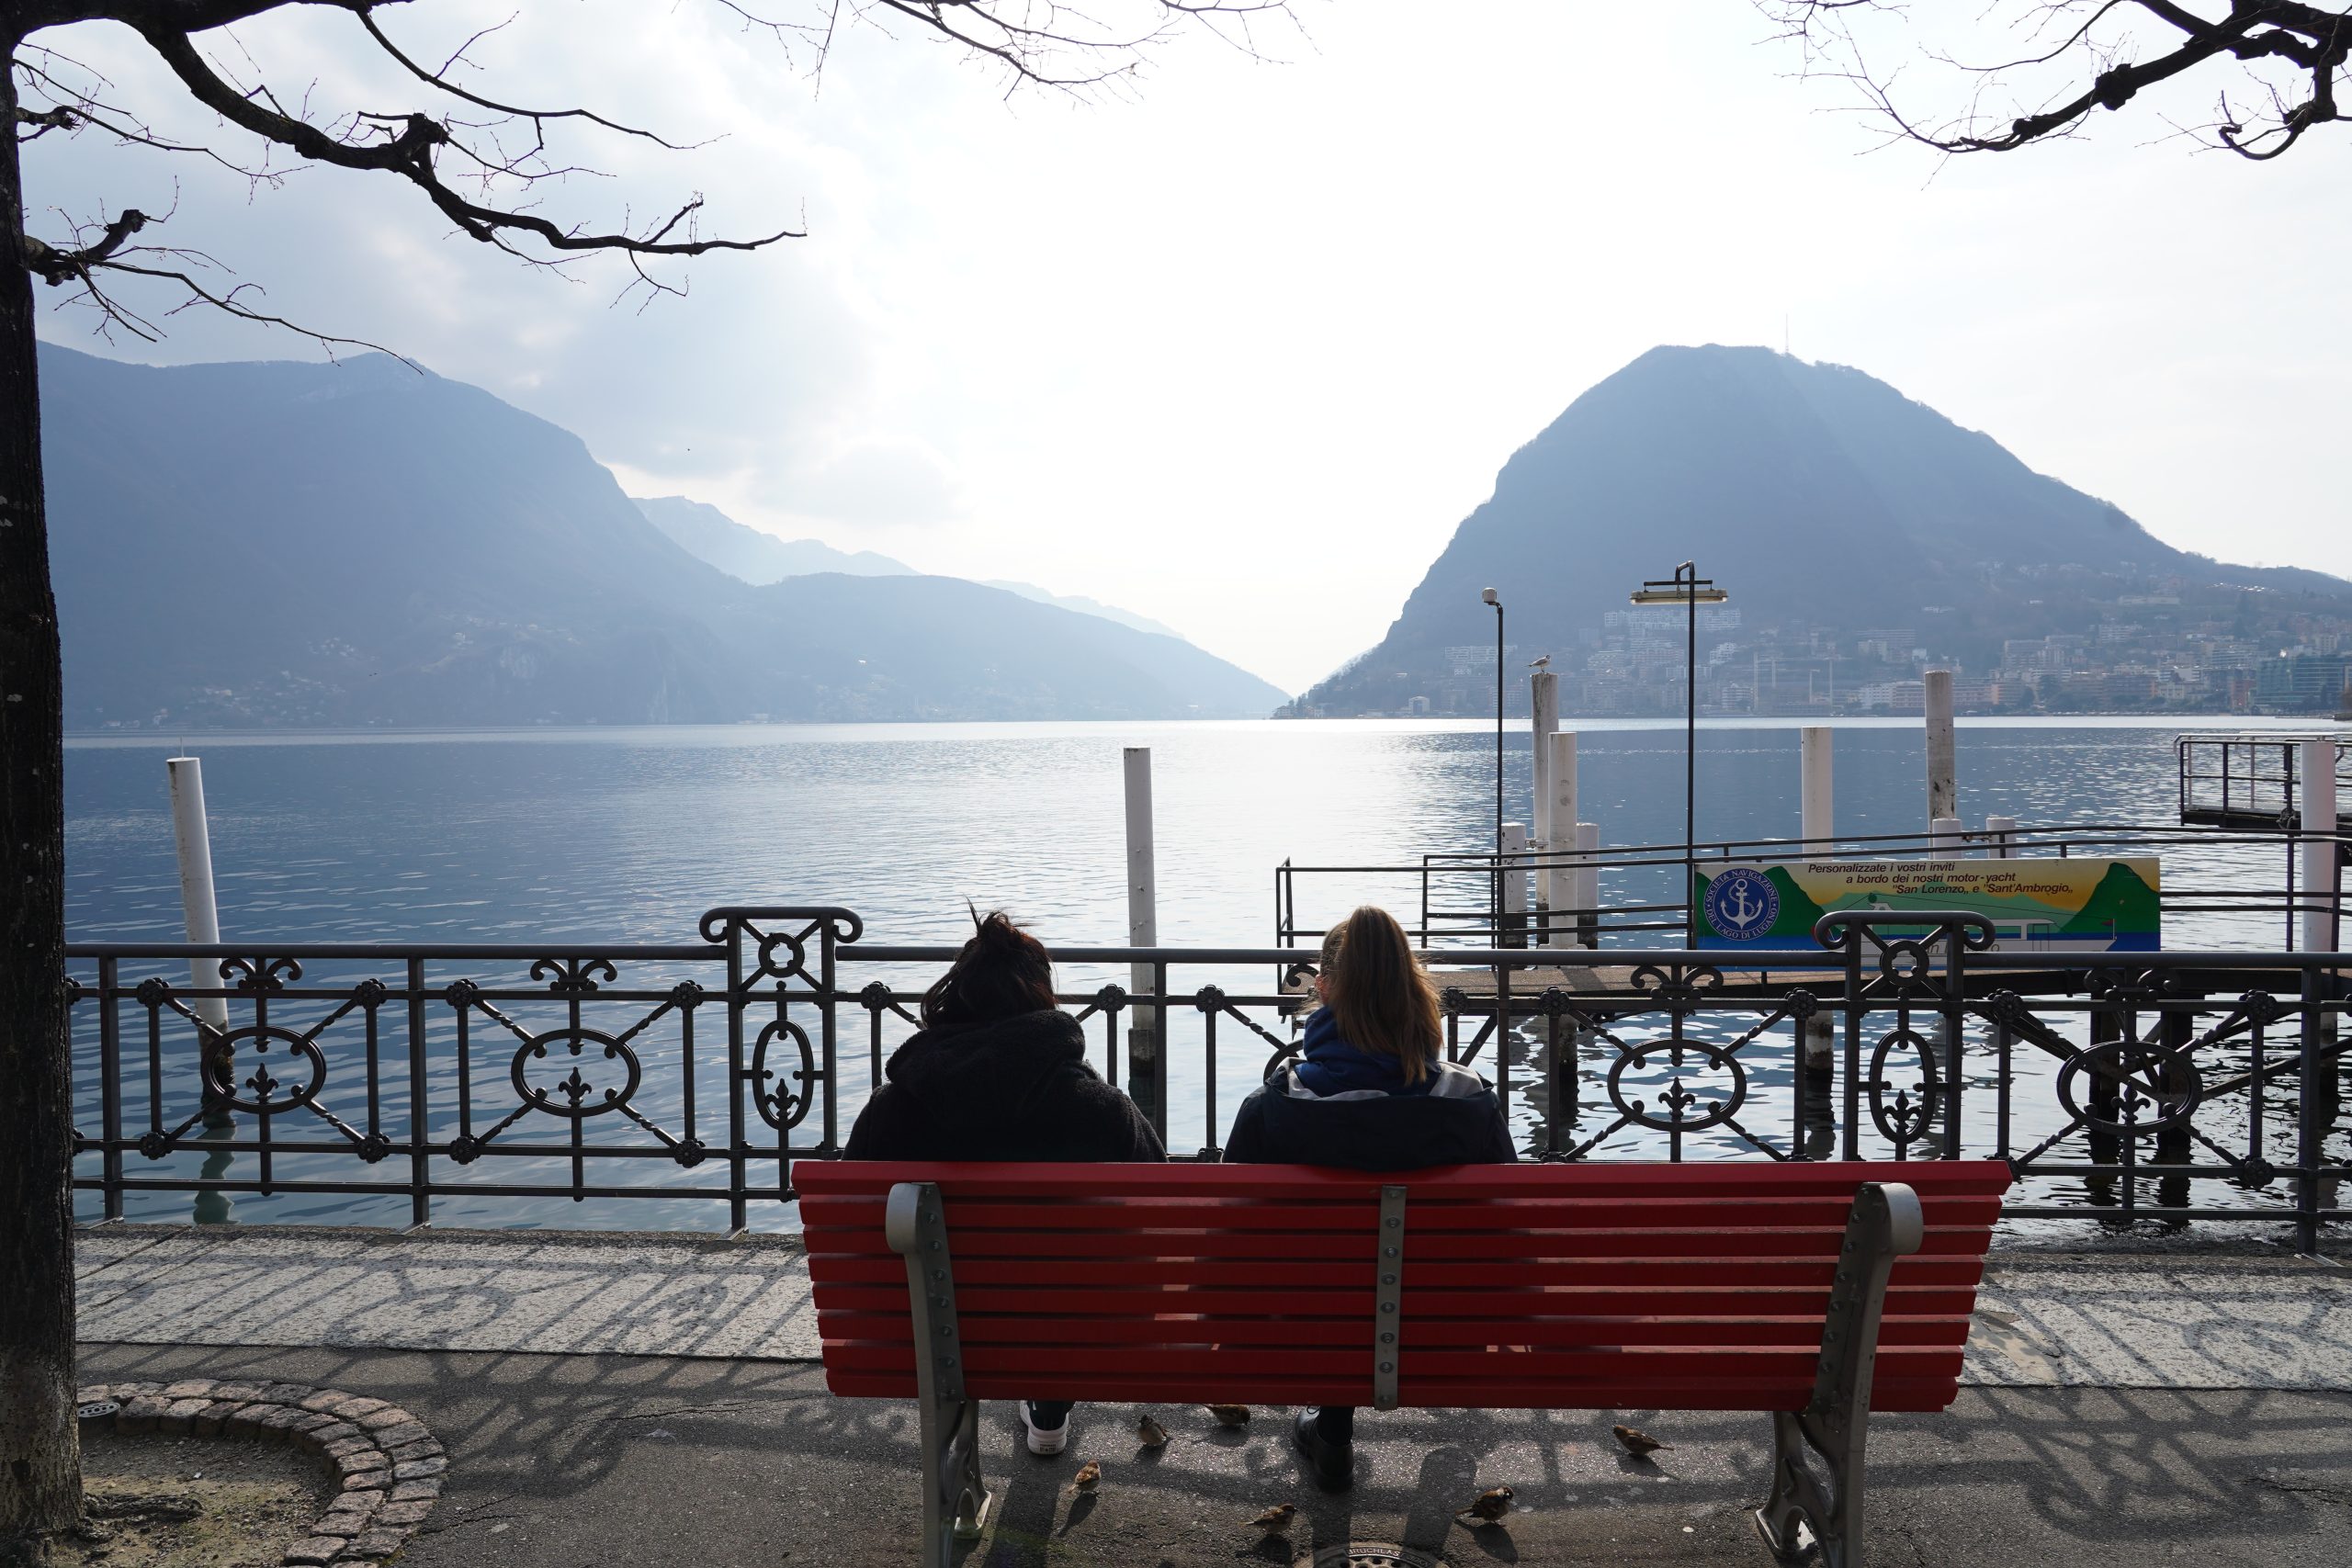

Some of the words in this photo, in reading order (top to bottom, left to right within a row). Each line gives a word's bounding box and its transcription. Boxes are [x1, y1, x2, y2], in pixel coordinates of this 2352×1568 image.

[1808, 863, 1887, 874] Personalizzate
[1890, 863, 1894, 872] i
[1897, 862, 1927, 872] vostri
[1929, 862, 1955, 872] inviti
[1846, 875, 1853, 884] a
[1857, 874, 1889, 884] bordo
[1893, 874, 1909, 883] dei
[1913, 873, 1944, 883] nostri
[1731, 870, 1779, 903] NAVIGAZIONE
[1707, 908, 1717, 926] DEL
[1717, 923, 1738, 939] LAGO
[1741, 931, 1751, 940] DI
[1752, 908, 1778, 937] LUGANO
